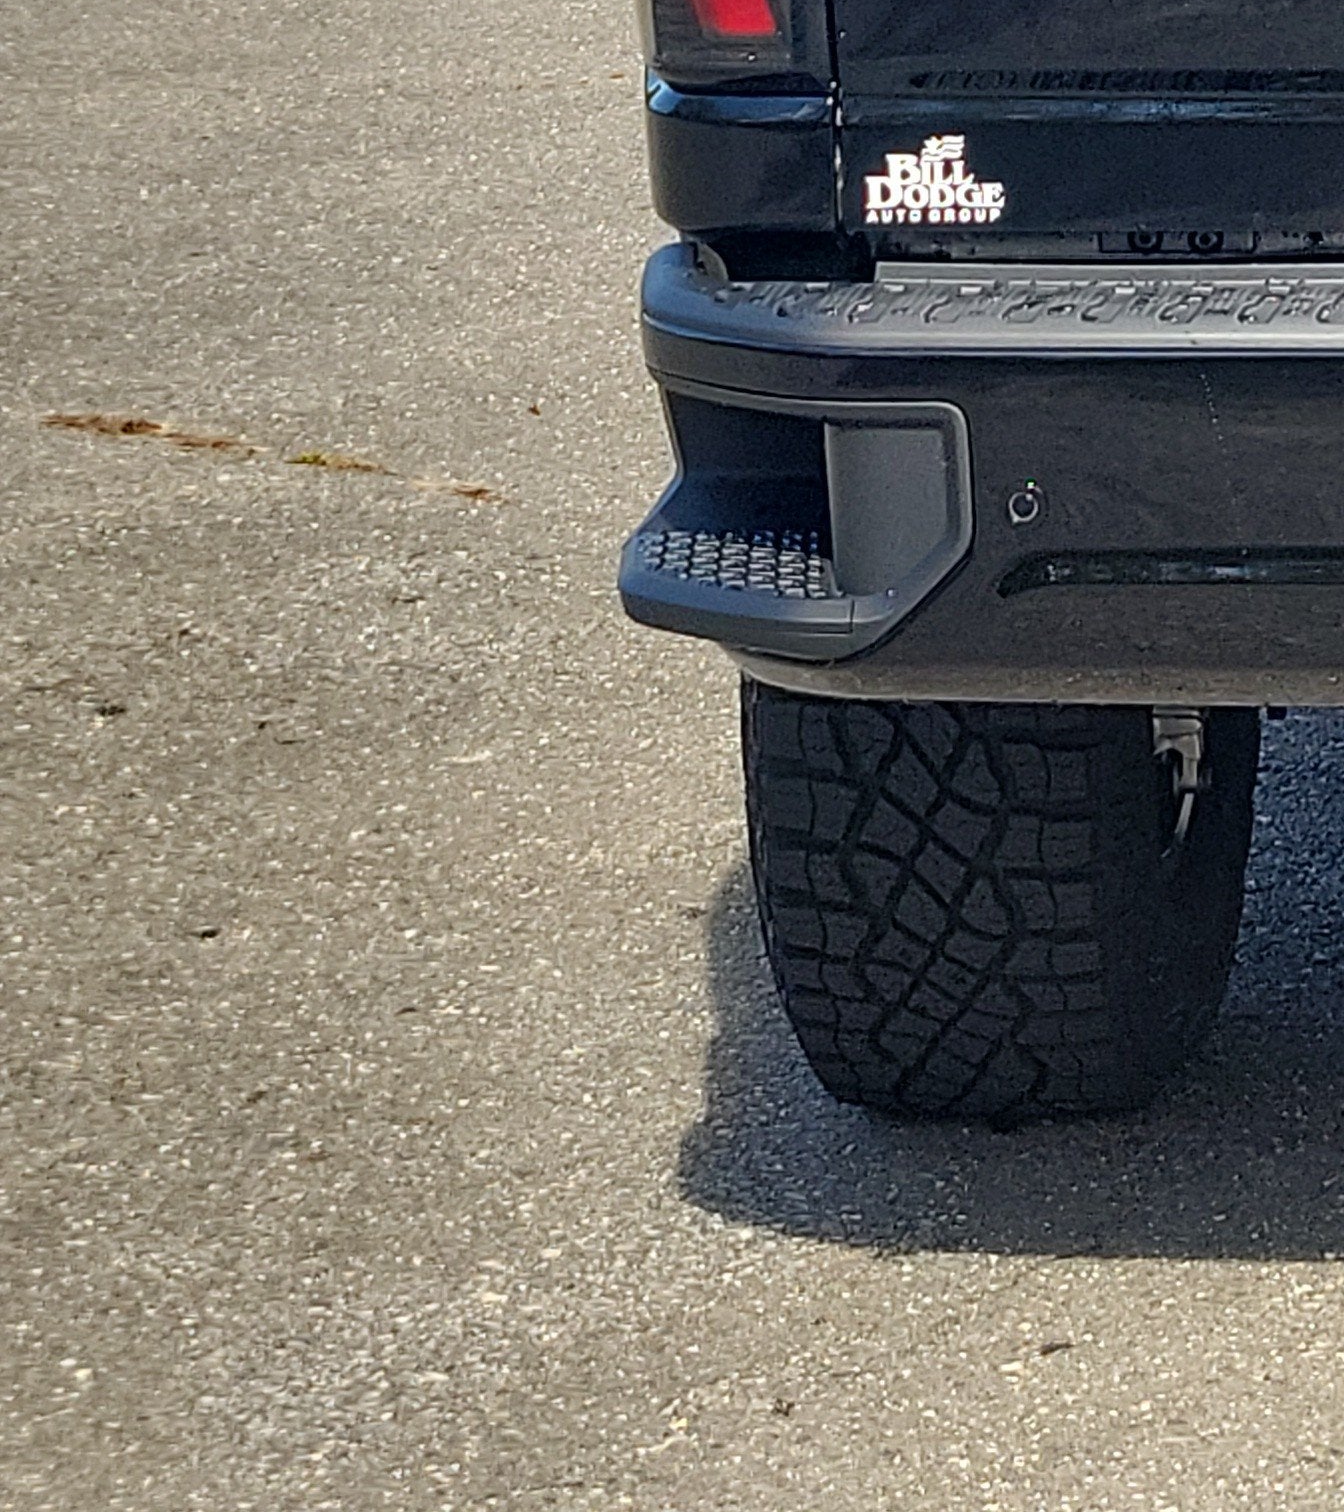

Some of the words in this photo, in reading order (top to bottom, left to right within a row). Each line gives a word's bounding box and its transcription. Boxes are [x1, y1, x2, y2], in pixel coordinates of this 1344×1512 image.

[885, 153, 975, 186] BILL
[864, 175, 1006, 209] DODGE
[865, 208, 922, 225] AUTO
[928, 208, 1001, 224] GROUP
